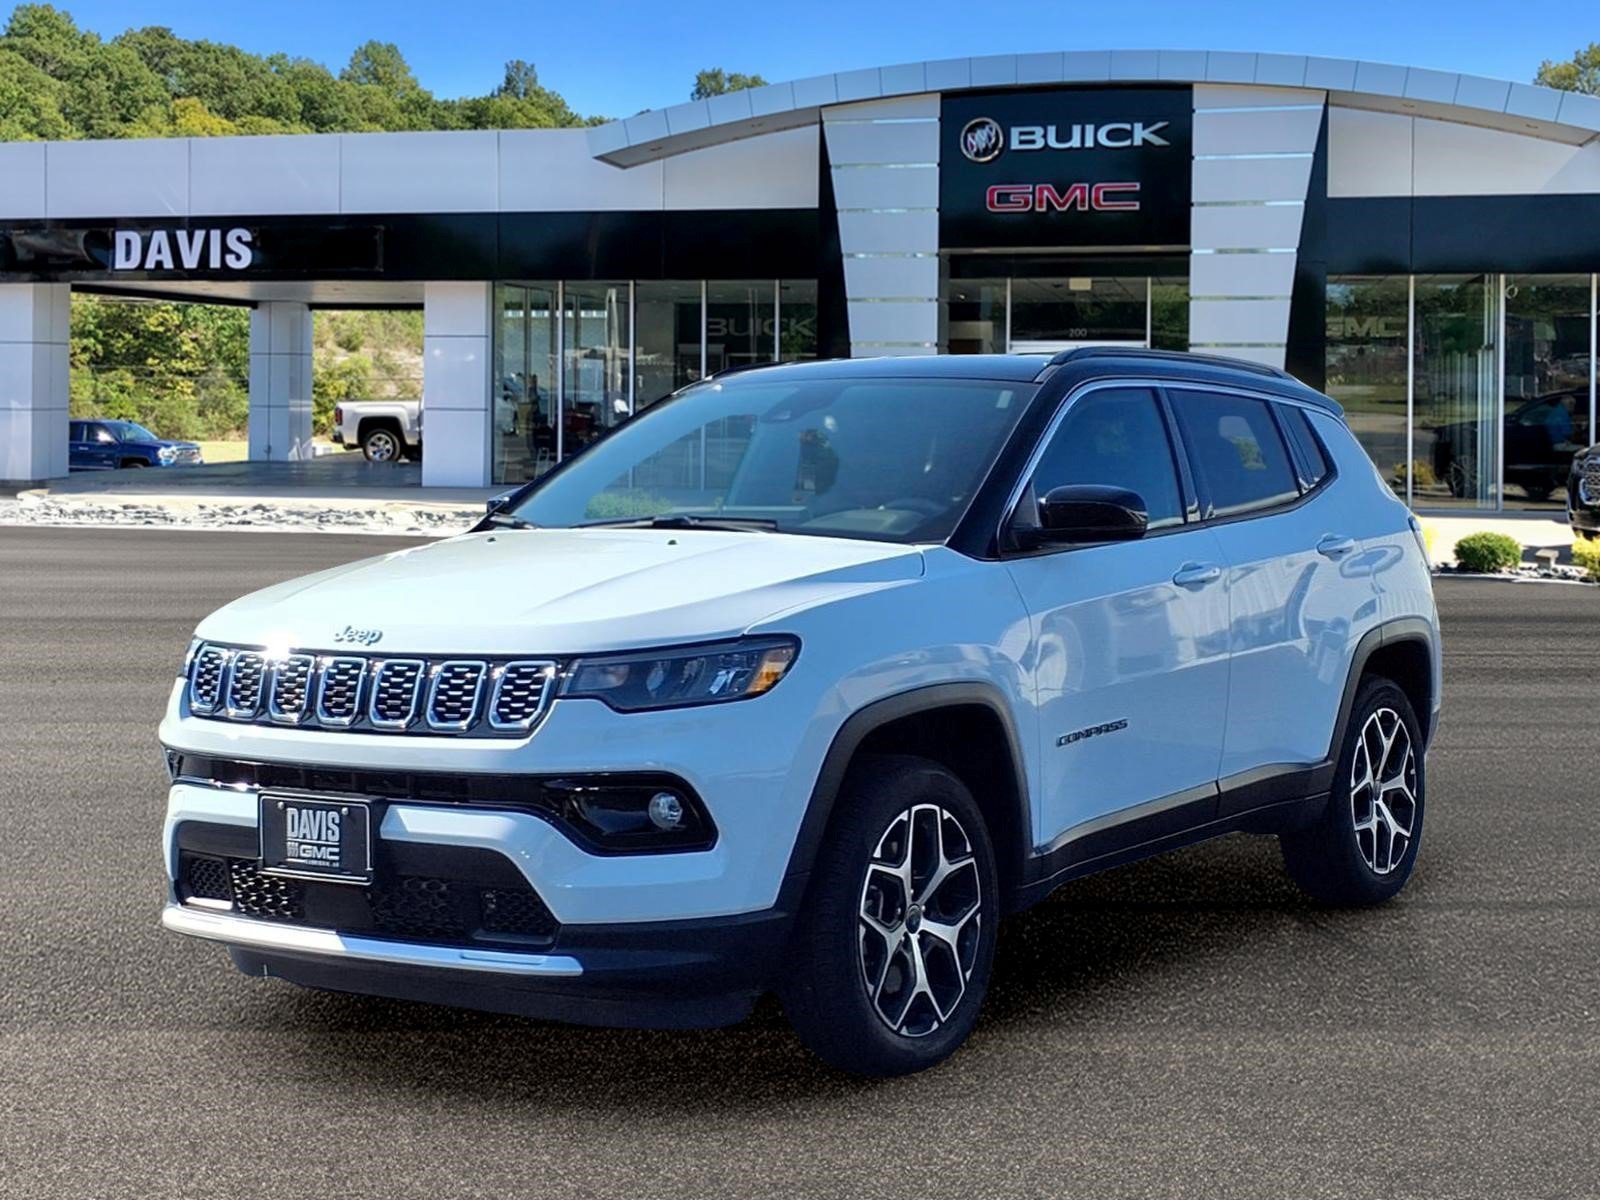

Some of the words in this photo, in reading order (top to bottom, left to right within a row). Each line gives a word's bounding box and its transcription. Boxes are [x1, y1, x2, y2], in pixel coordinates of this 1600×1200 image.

[1010, 121, 1170, 150] BUICK
[986, 182, 1140, 212] GMC
[114, 228, 253, 270] DAVIS
[705, 317, 816, 337] BUICK
[1069, 328, 1087, 338] 200
[333, 625, 383, 646] Jeep
[1056, 718, 1128, 747] COMPASS
[286, 807, 340, 842] DAVIS
[300, 844, 340, 860] GMC
